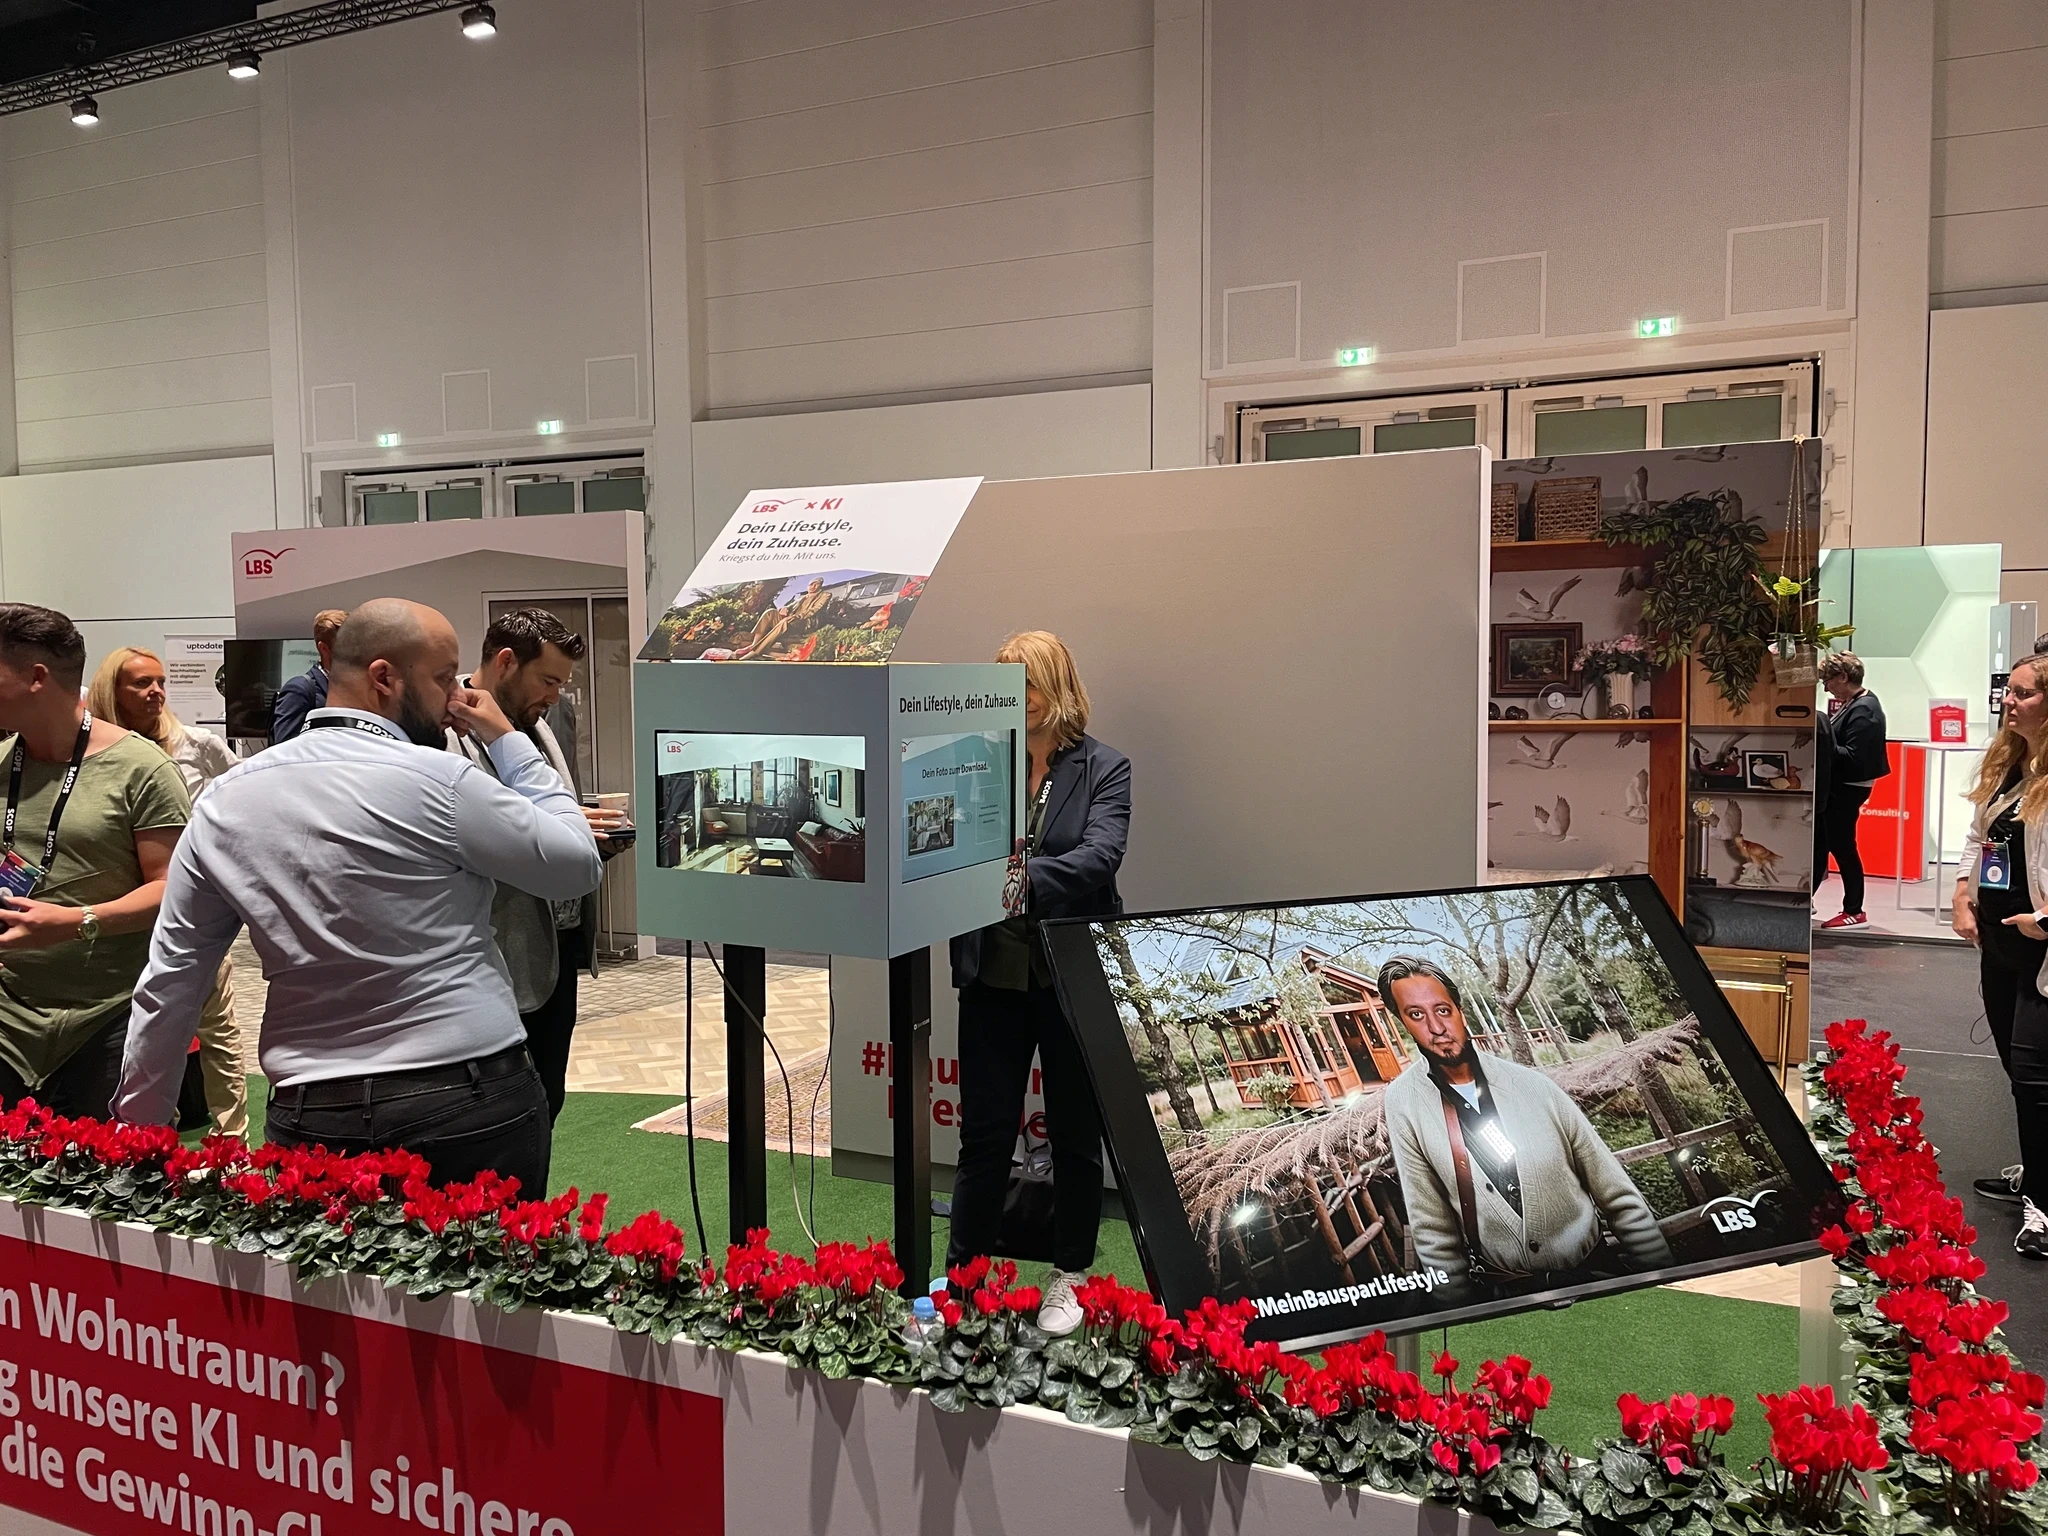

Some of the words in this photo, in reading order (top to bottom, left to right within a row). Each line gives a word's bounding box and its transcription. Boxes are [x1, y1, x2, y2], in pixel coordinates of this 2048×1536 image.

[752, 505, 779, 513] LBS
[820, 498, 844, 510] KI
[737, 521, 777, 534] Dein
[779, 519, 853, 535] Lifestyle,
[727, 538, 764, 550] dein
[766, 537, 842, 549] Zuhause.
[246, 559, 273, 575] LBS
[719, 554, 756, 564] Kriegst
[756, 554, 772, 562] du
[773, 553, 793, 561] hin.
[794, 552, 814, 560] Mit
[815, 552, 837, 560] uns.
[186, 642, 223, 651] uptodate
[899, 696, 922, 713] Dein
[923, 694, 963, 716] Lifestyle,
[964, 693, 983, 711] dein
[984, 692, 1019, 709] Zuhause.
[13, 745, 24, 772] SCOPE
[667, 745, 682, 753] LBS
[62, 766, 77, 793] SCOPE
[922, 769, 936, 779] Dein
[936, 766, 949, 776] Foto
[949, 765, 960, 775] zum
[961, 761, 989, 774] Download.
[1038, 780, 1053, 804] SCOPE
[5, 808, 15, 832] SCOP
[1710, 1207, 1757, 1234] LBS
[1252, 1266, 1450, 1319] MeinBausparLifestyle
[30, 1282, 345, 1416] Wohntraum?
[30, 1368, 178, 1450] unsere
[191, 1402, 239, 1470] KI
[255, 1434, 353, 1504] und
[1, 1420, 64, 1489] die
